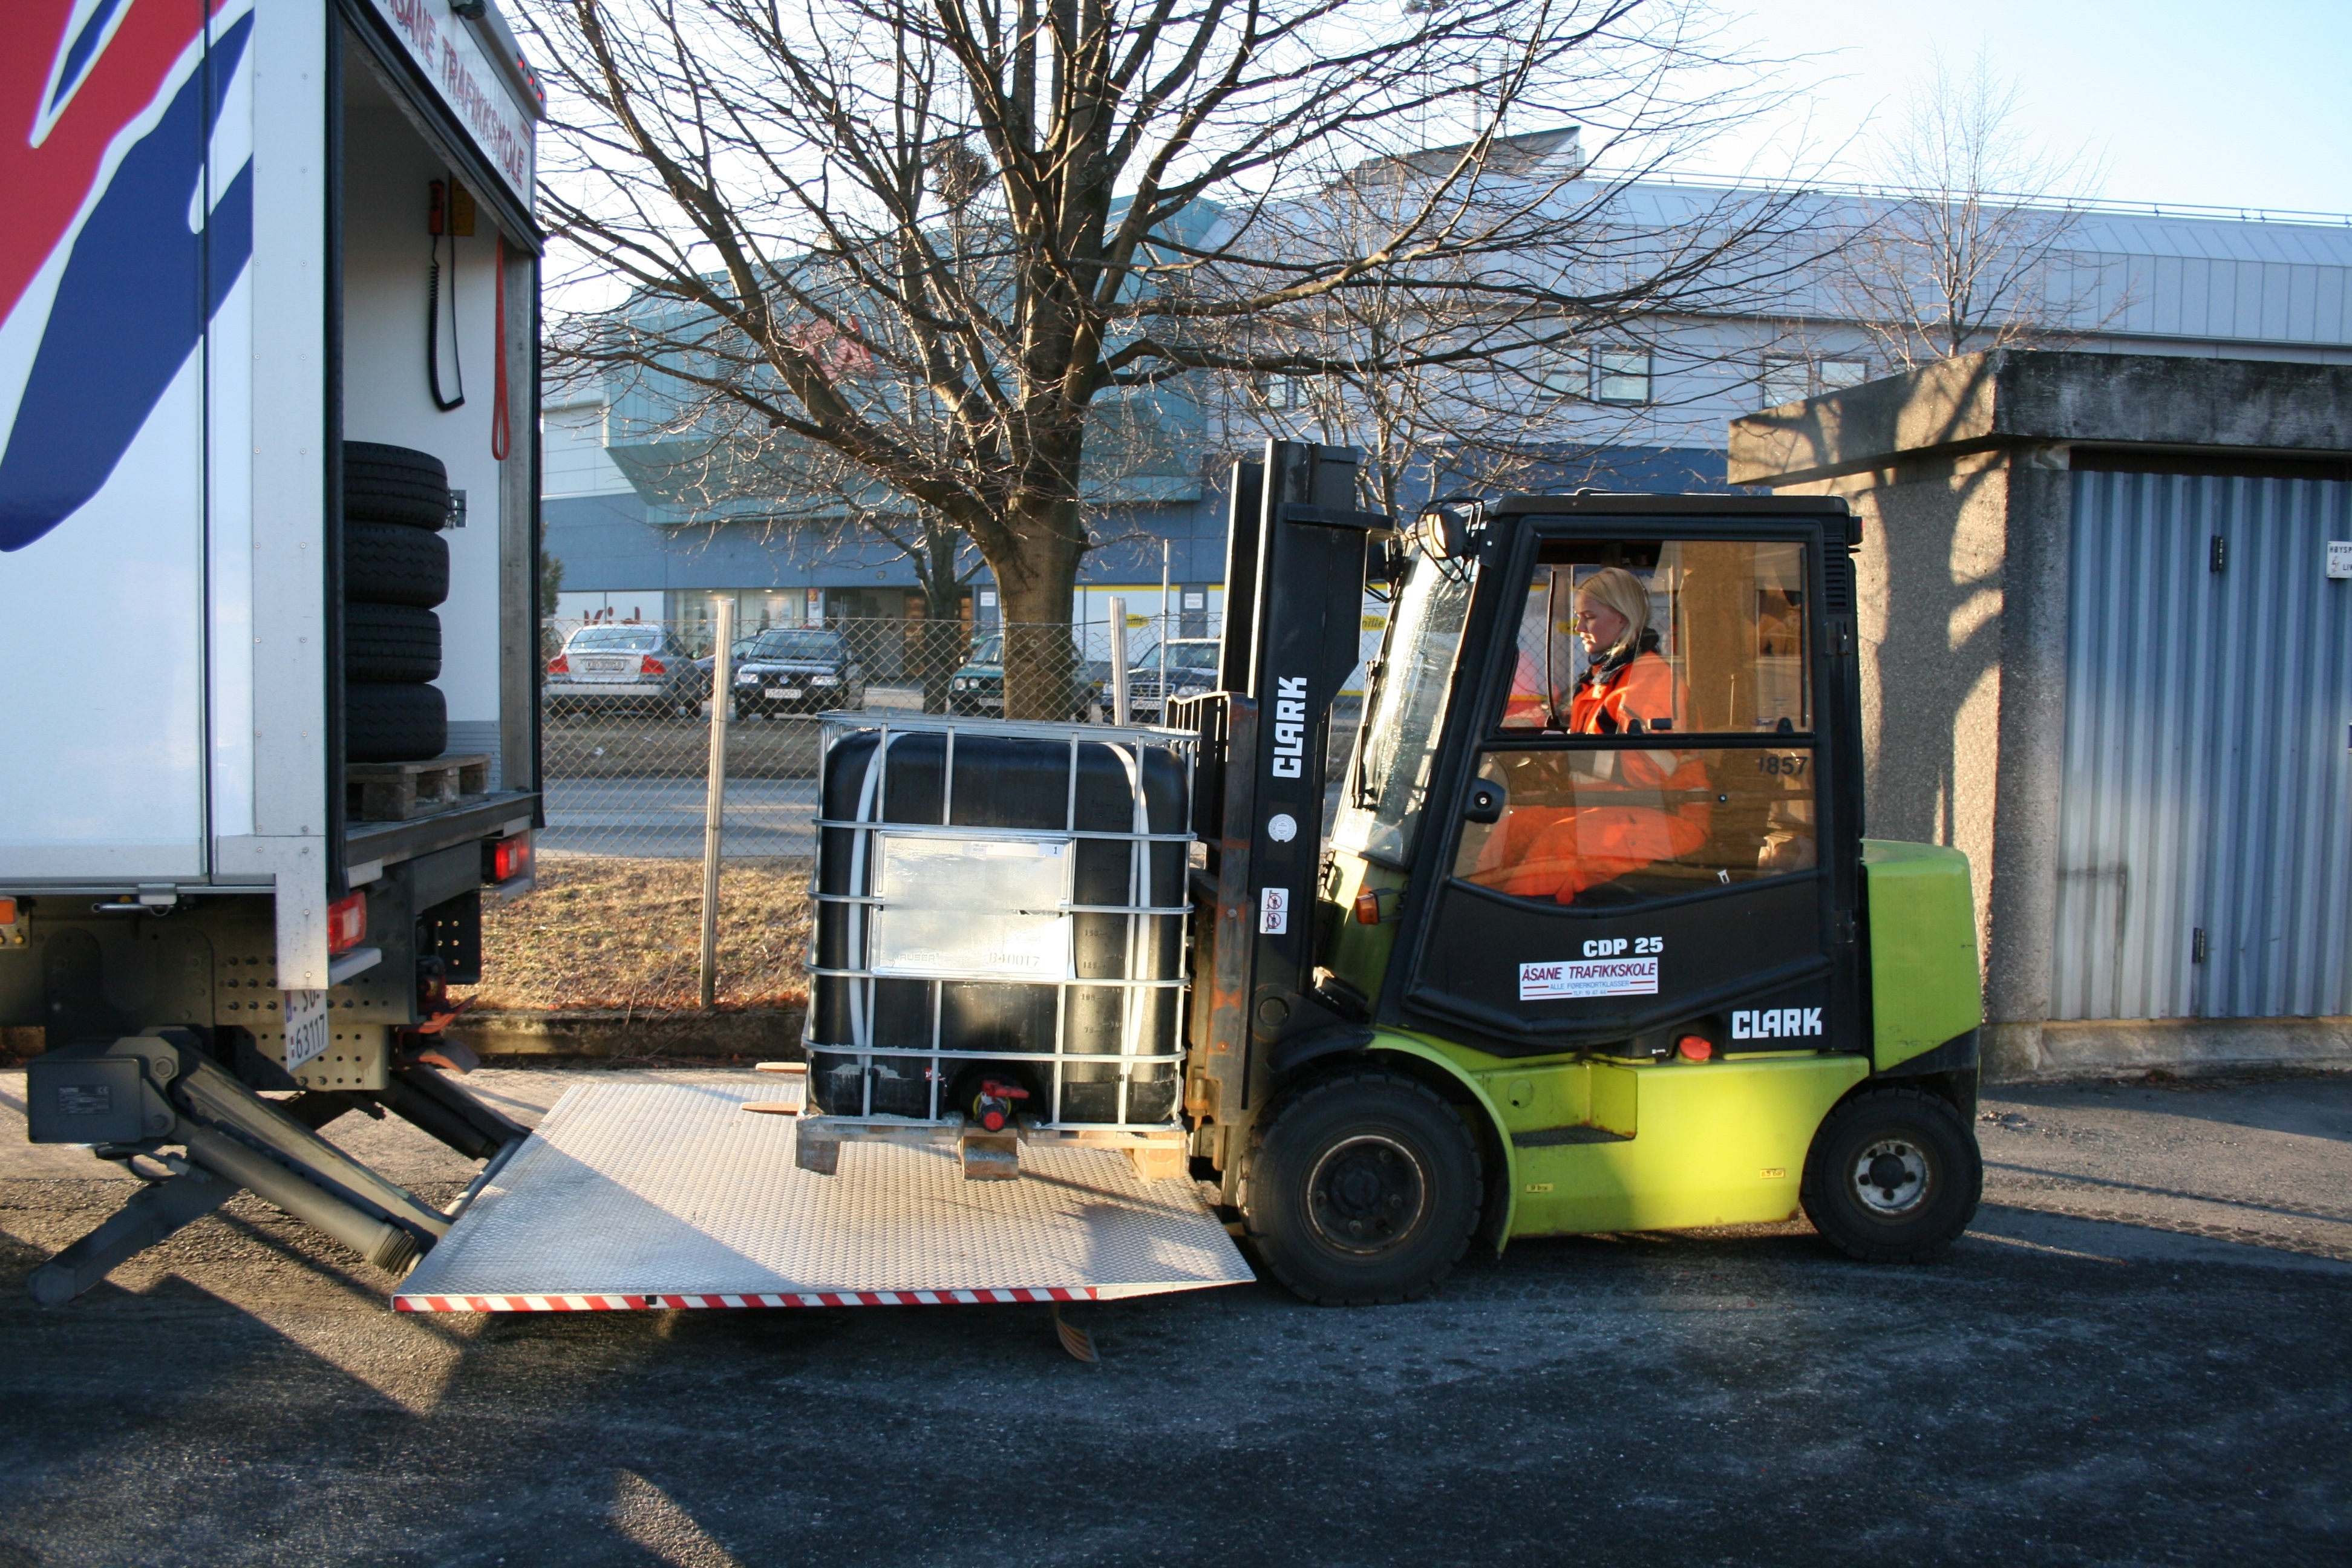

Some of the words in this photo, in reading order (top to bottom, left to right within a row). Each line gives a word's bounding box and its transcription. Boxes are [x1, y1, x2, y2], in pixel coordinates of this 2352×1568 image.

[384, 0, 436, 70] SANE
[442, 35, 524, 190] TRAFIKKSKOLE
[1273, 676, 1307, 779] CLARK
[1759, 756, 1808, 774] 1857
[1583, 939, 1627, 957] CDP
[1635, 937, 1664, 953] 25
[1521, 965, 1563, 981] ÅSANE
[1569, 962, 1656, 979] TRAFIKKSKOLE
[1567, 981, 1629, 989] FØRERKORTKLASSER
[1732, 1008, 1822, 1039] CLARK
[296, 1014, 325, 1059] 63117
